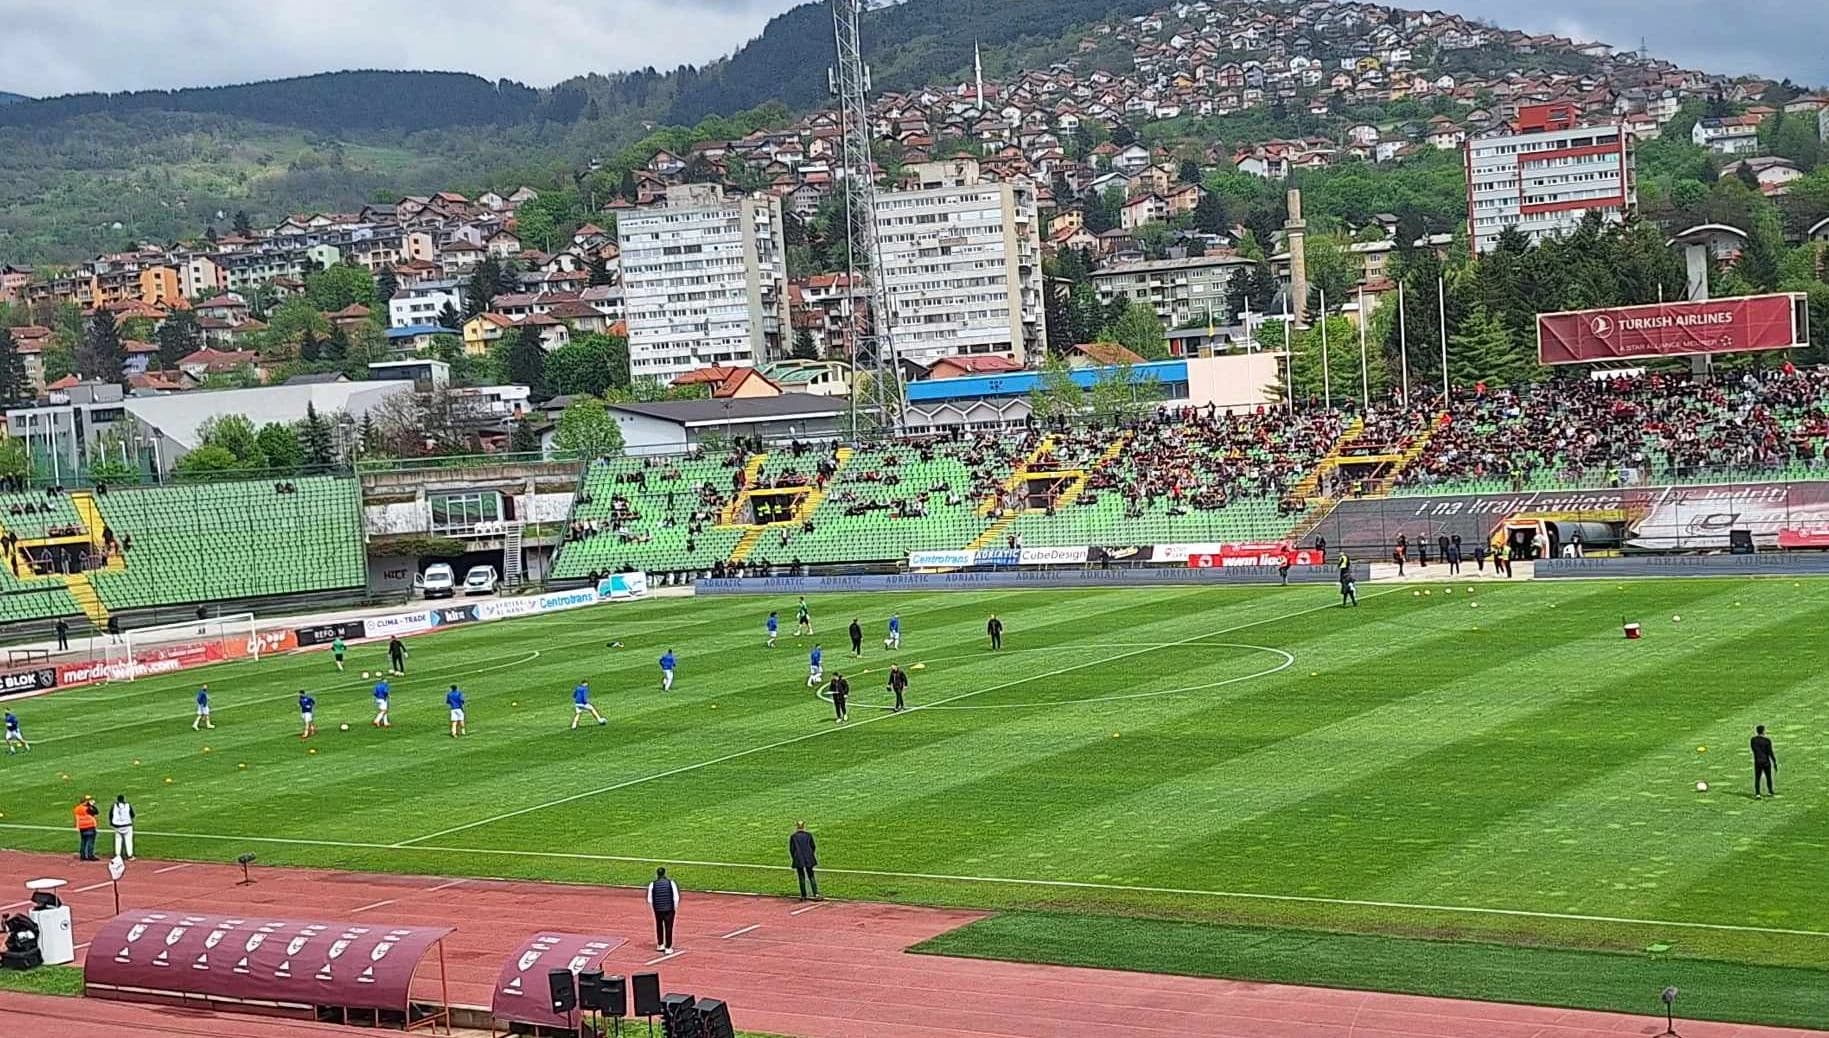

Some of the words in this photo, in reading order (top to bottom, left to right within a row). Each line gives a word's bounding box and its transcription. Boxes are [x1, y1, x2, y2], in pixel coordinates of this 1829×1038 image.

[1618, 316, 1672, 330] TURKISH
[1676, 312, 1733, 326] AIRLINES
[1431, 501, 1464, 515] na
[911, 554, 969, 565] Centrotrans
[975, 549, 1021, 559] ADRIATIC
[1022, 549, 1087, 561] CubeDesign
[820, 577, 863, 585] ADRIATIC
[886, 575, 929, 585] ADRIATIC
[945, 573, 990, 582] ADRIATIC
[1016, 572, 1062, 581] ADRIATIC
[1079, 571, 1129, 580] ADRIATIC
[764, 578, 805, 586] ADRIATIC
[540, 593, 593, 608] Centrotrans
[377, 619, 398, 628] CLIMA
[404, 615, 426, 625] TRADE
[314, 627, 346, 639] REFOM
[6, 674, 37, 688] BLOK
